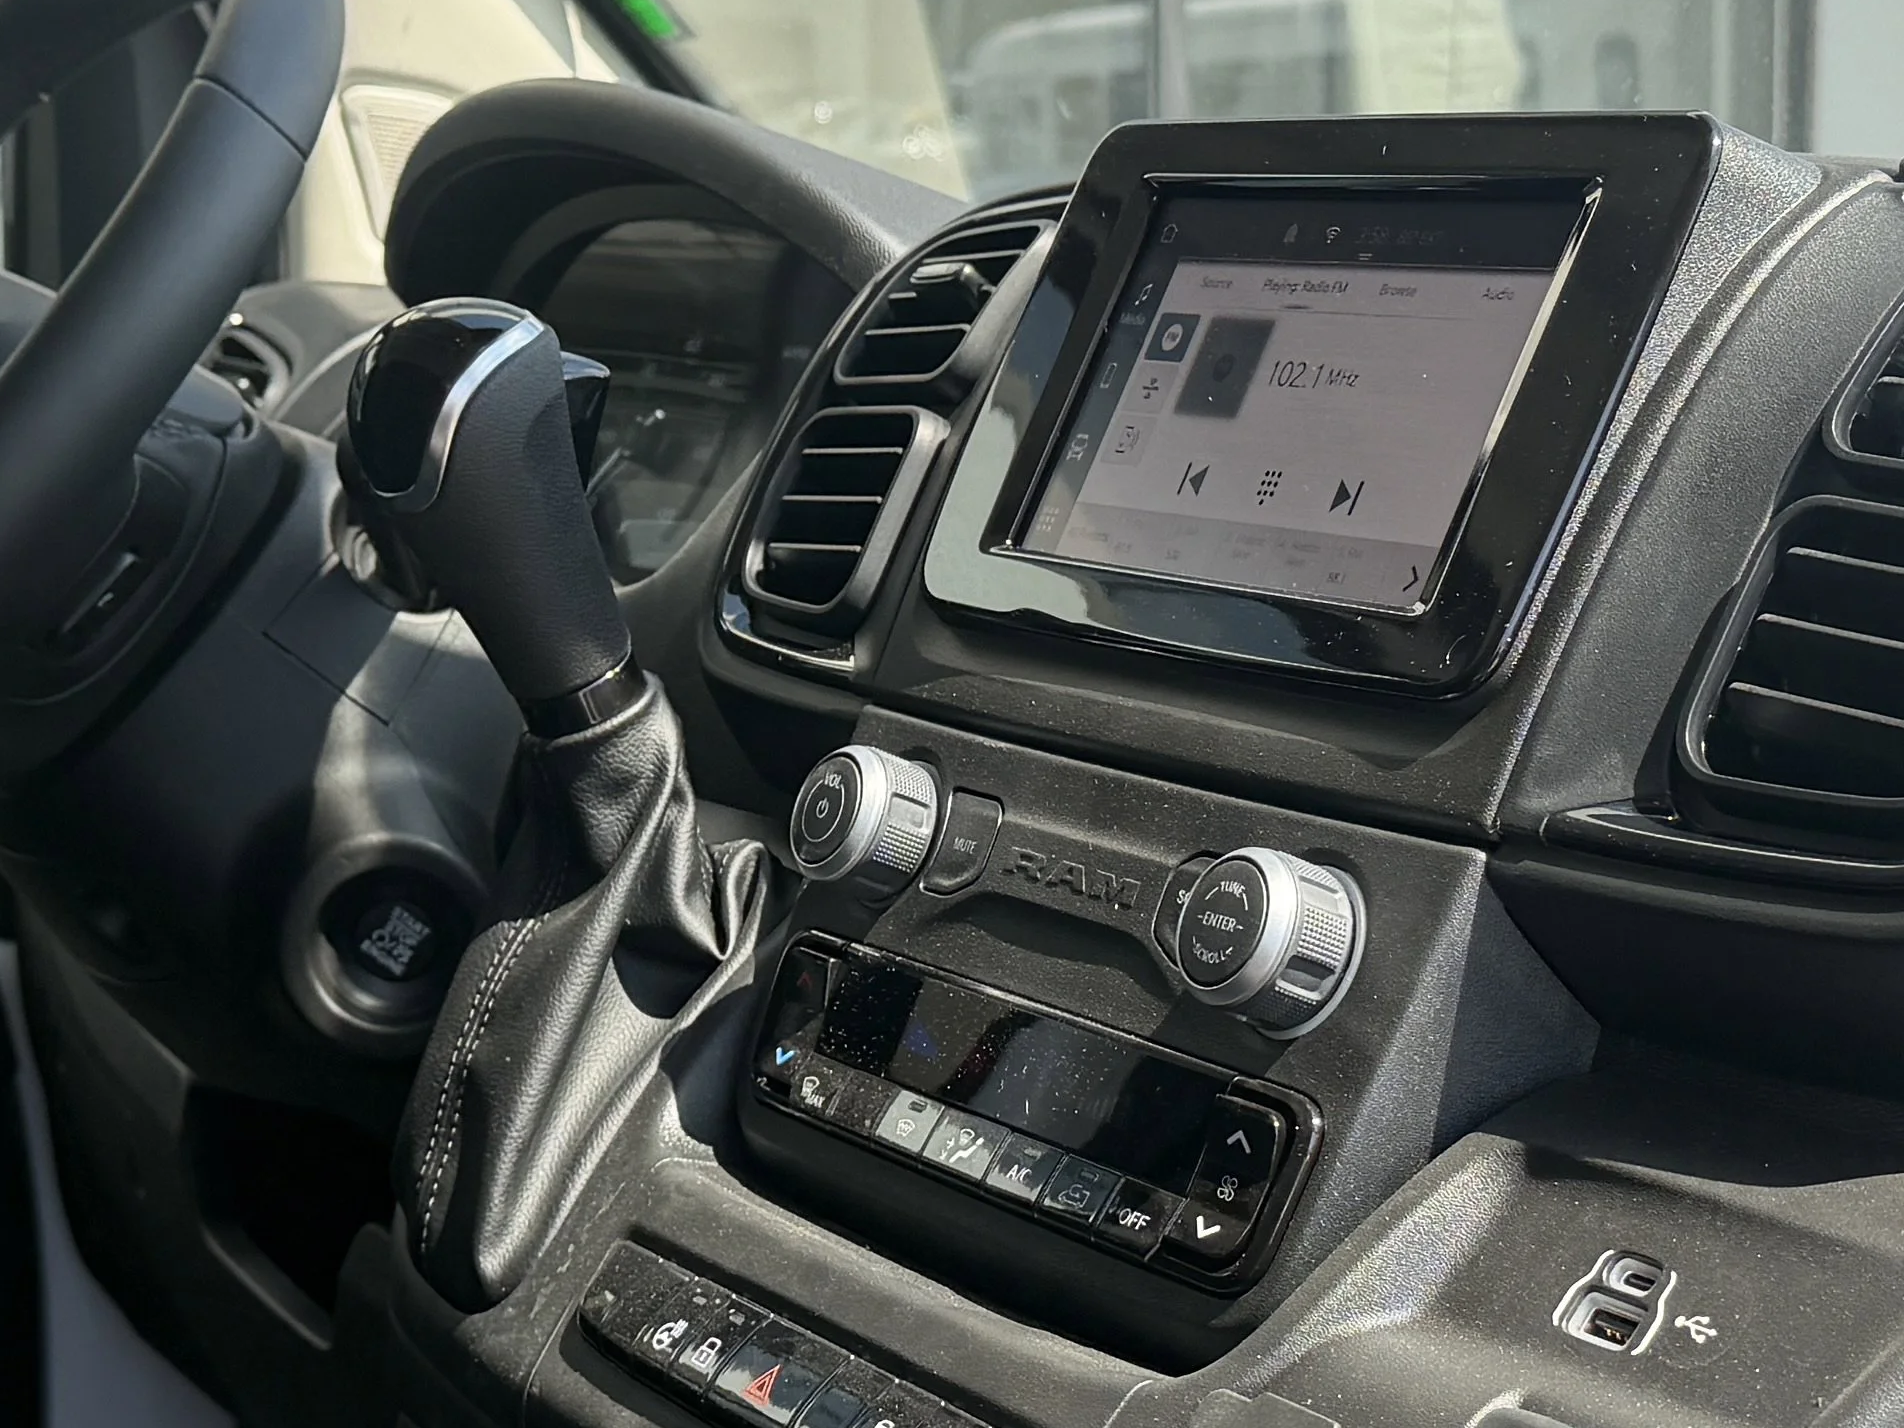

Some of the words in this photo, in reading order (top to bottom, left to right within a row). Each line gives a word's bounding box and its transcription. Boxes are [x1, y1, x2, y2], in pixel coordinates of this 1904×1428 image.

[1482, 287, 1515, 301] Audio
[1325, 372, 1360, 388] MHz
[824, 773, 842, 789] VOL
[955, 836, 978, 854] MUTE
[998, 846, 1142, 910] RAM
[1220, 880, 1245, 898] TUNE
[1202, 911, 1236, 932] ENTER
[1193, 943, 1226, 964] SCROLL
[805, 1092, 826, 1108] MAX
[1006, 1164, 1032, 1185] A/C
[1119, 1208, 1151, 1230] OFF
